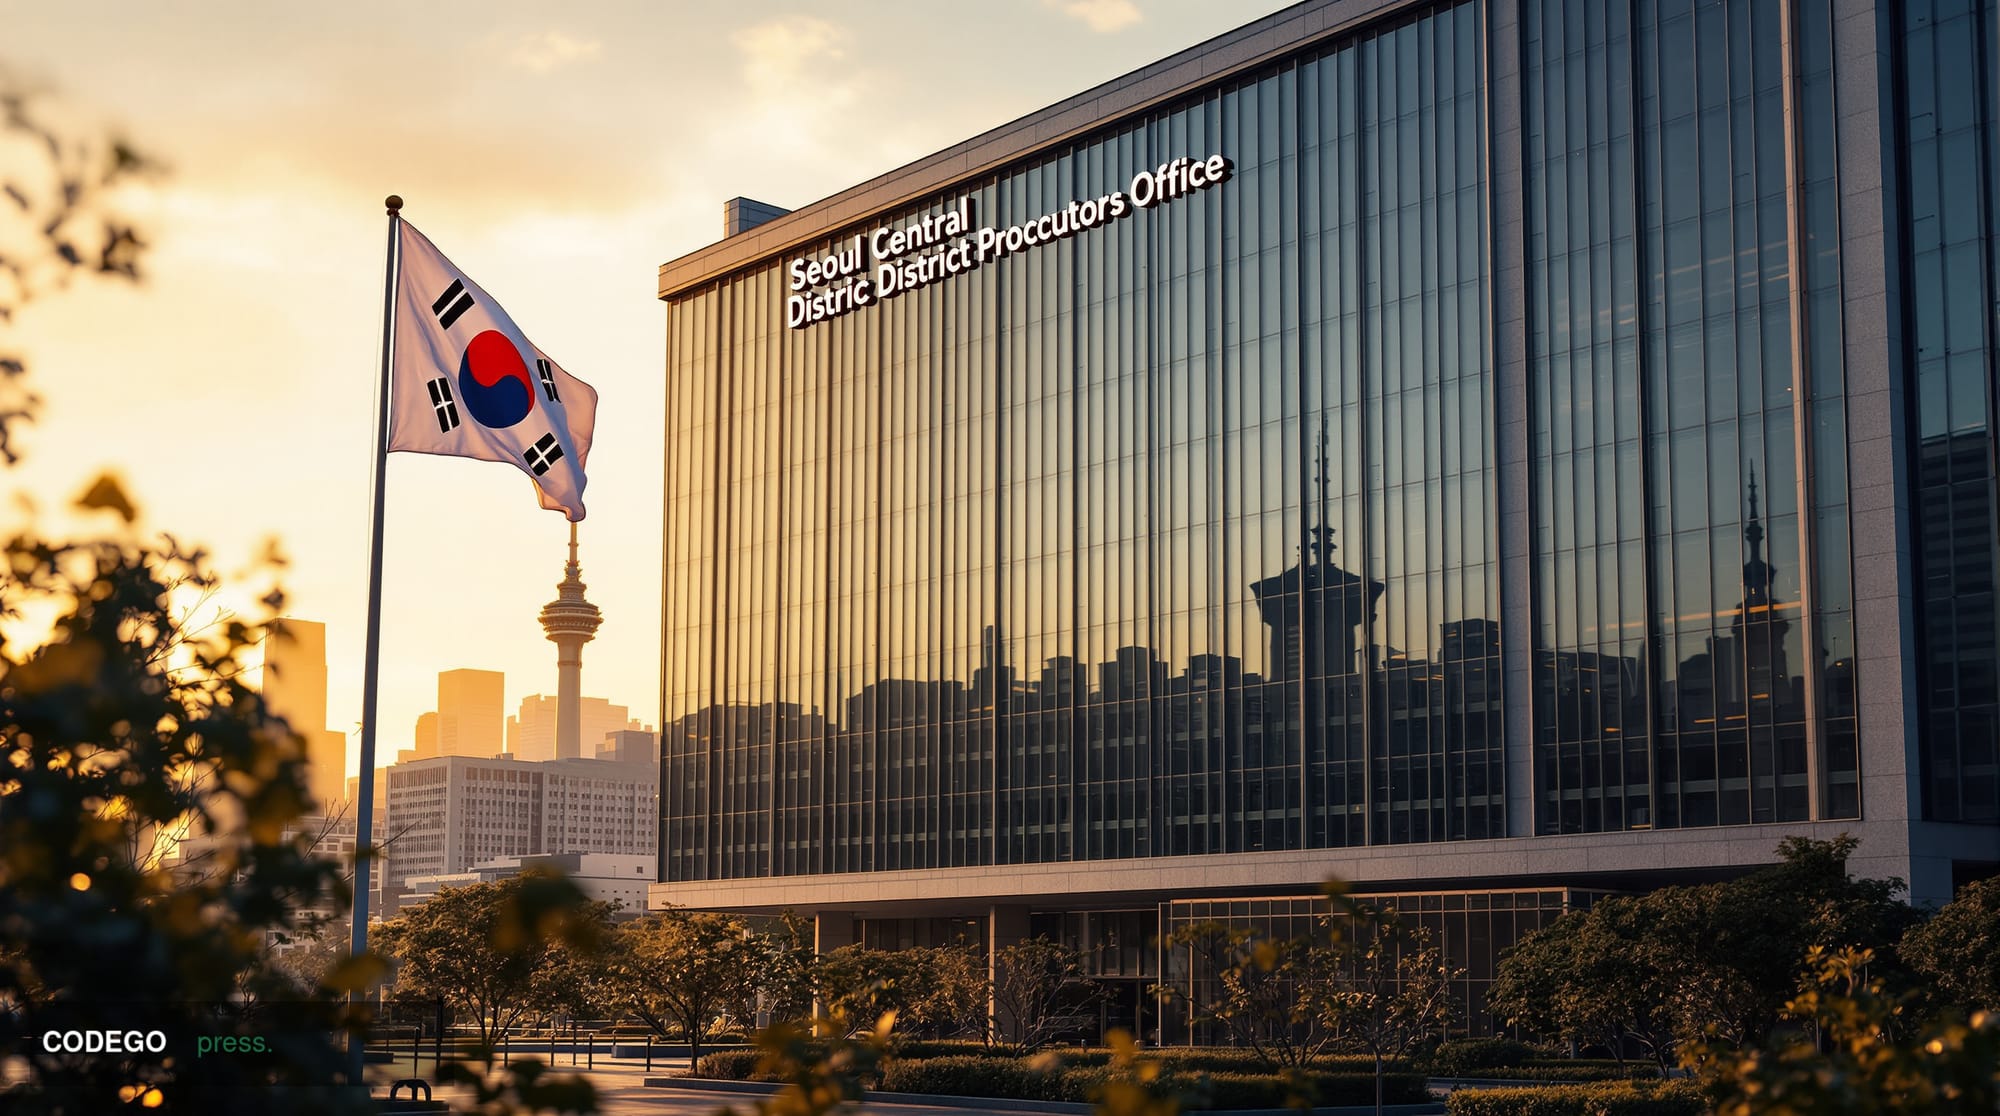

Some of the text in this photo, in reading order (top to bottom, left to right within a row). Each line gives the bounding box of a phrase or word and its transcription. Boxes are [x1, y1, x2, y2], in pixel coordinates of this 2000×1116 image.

[787, 154, 1225, 328] Distric District Proccutors Office
[790, 196, 969, 291] Seoul Central
